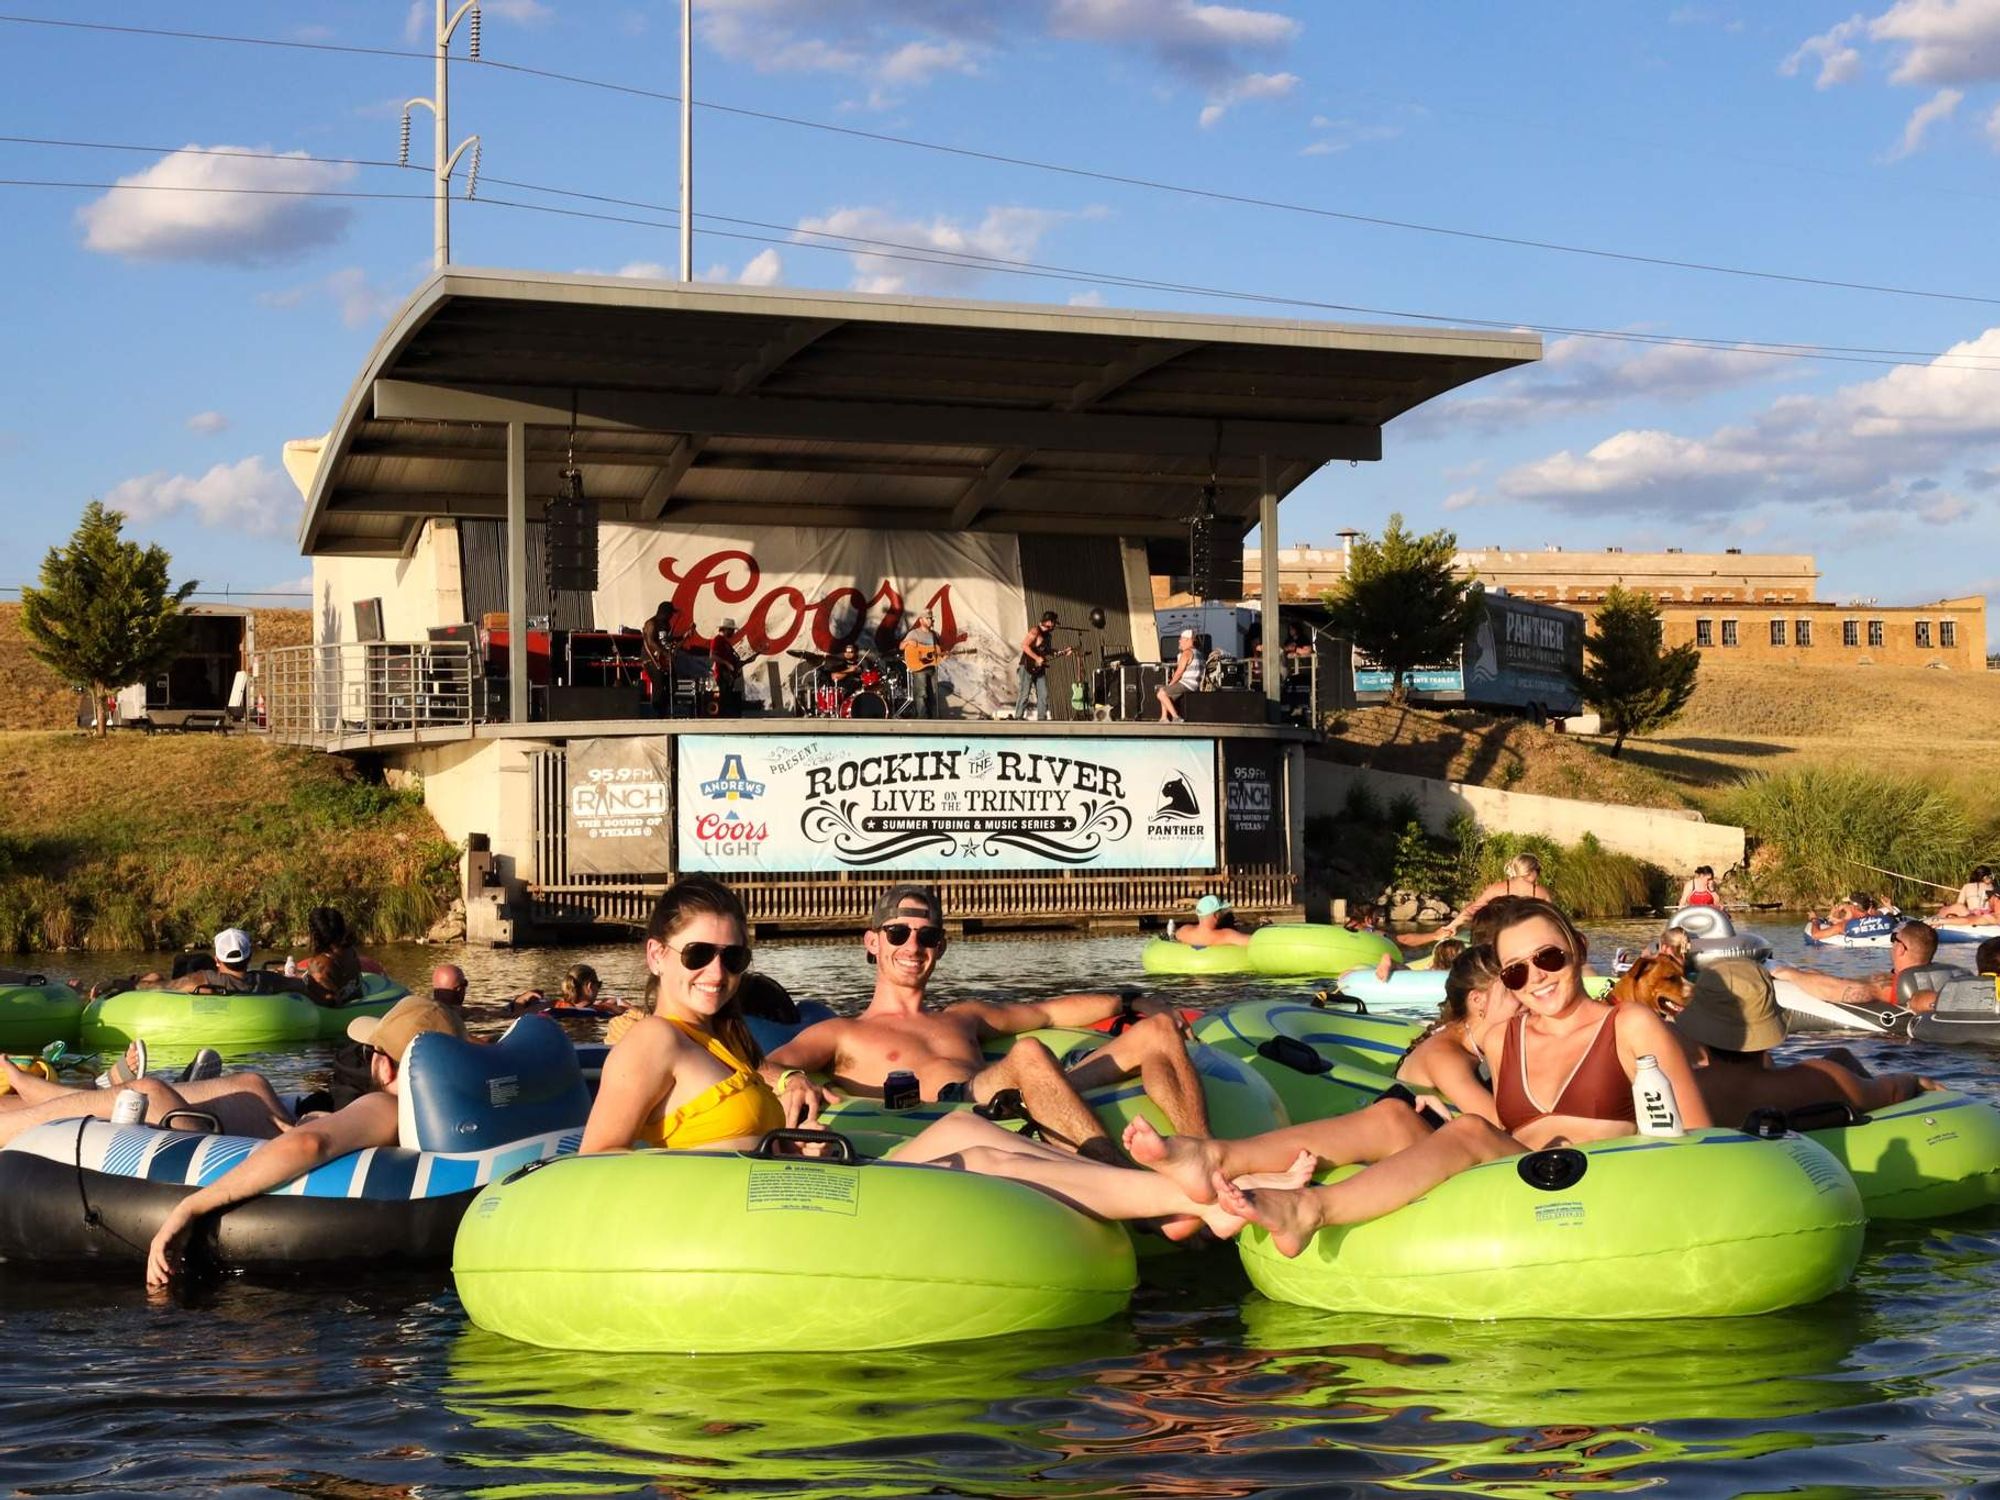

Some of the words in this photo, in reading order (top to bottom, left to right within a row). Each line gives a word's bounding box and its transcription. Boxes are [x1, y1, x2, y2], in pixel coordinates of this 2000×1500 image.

[658, 550, 968, 656] Coors
[1506, 612, 1564, 650] PANTHER
[769, 742, 818, 774] PRESENT
[805, 745, 970, 800] ROCKIN'
[968, 757, 993, 774] THE
[997, 751, 1126, 799] RIVER
[703, 781, 763, 794] ANDREWS
[872, 790, 935, 812] LIVE
[944, 791, 958, 801] ON
[964, 790, 1071, 812] TRINITY
[941, 801, 961, 811] THE
[576, 820, 601, 828] THE
[695, 813, 769, 840] Coors
[882, 819, 928, 830] SUMMER
[932, 819, 970, 830] TUBING
[974, 819, 981, 830] &
[985, 819, 1018, 830] MUSIC
[1021, 819, 1056, 829] SERIES
[1147, 825, 1204, 835] PANTHER
[599, 828, 642, 837] TEXAS
[704, 842, 760, 856] LIGHT
[1851, 923, 1890, 934] TEXAS
[1644, 1090, 1674, 1130] Lite
